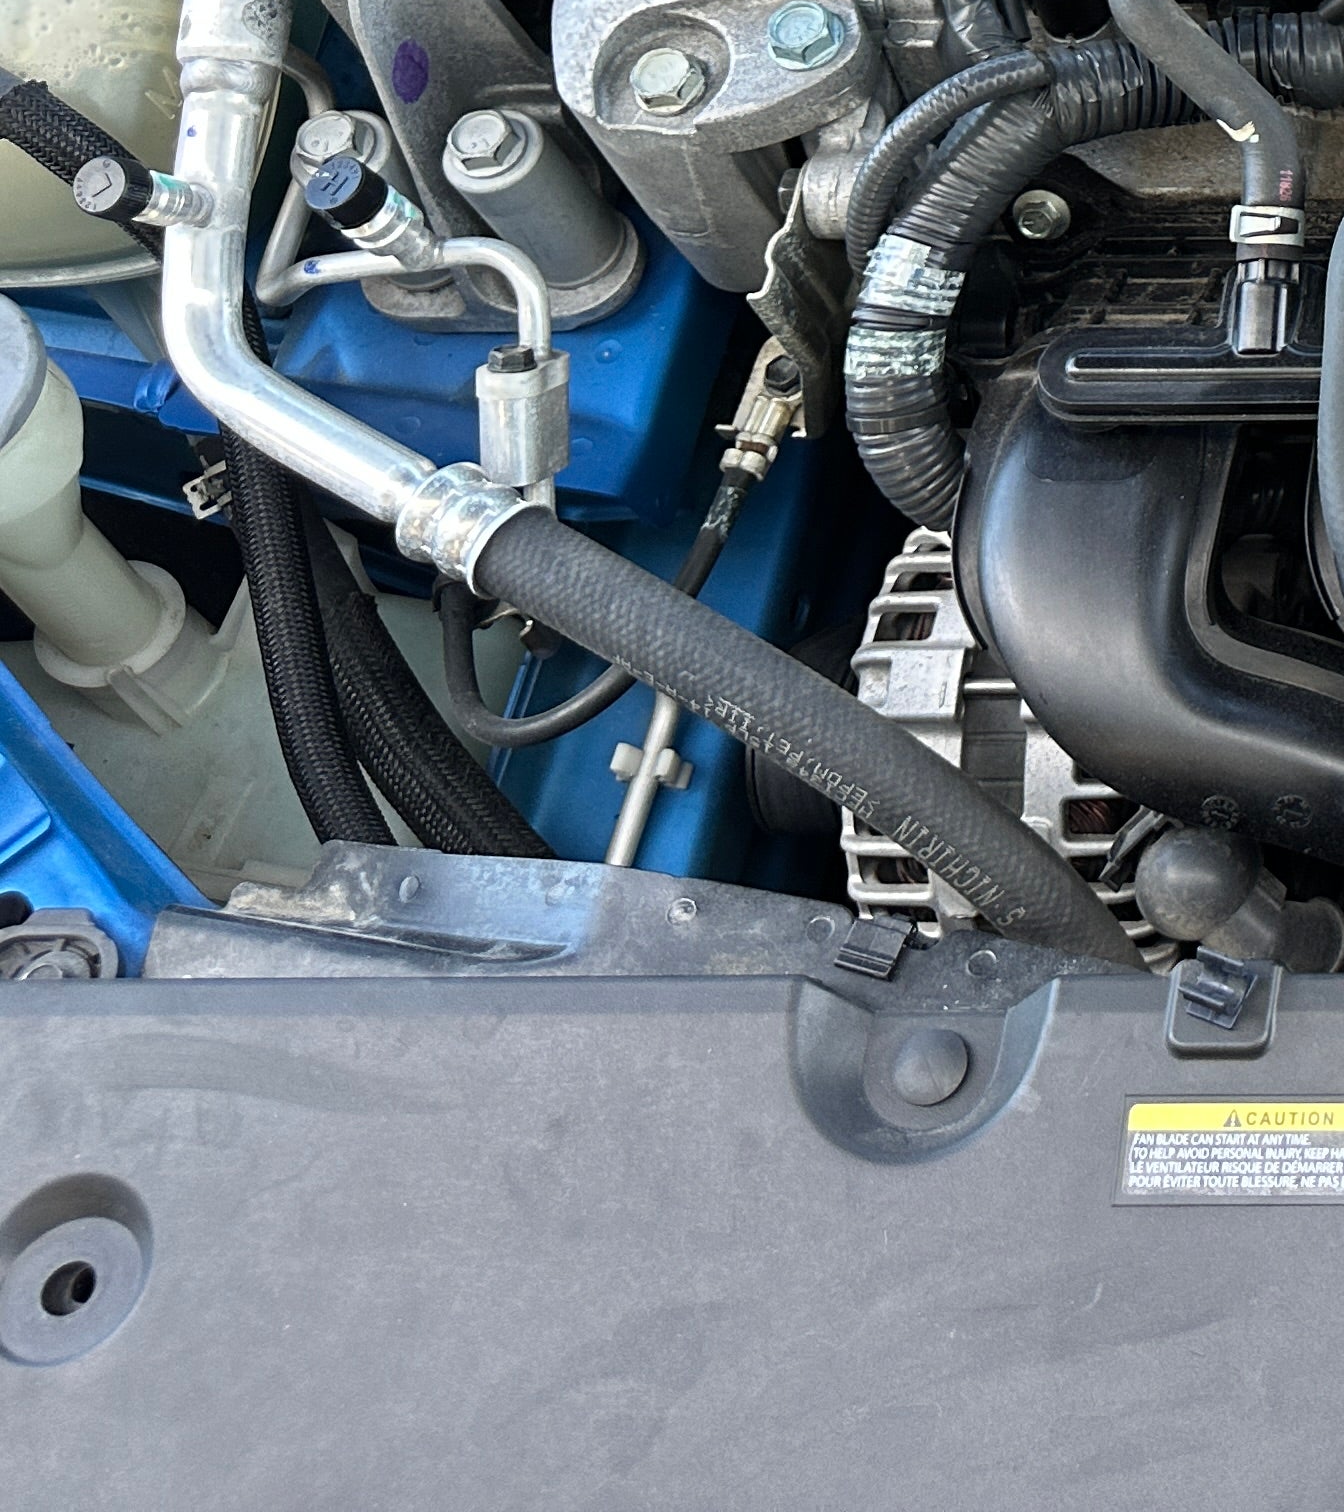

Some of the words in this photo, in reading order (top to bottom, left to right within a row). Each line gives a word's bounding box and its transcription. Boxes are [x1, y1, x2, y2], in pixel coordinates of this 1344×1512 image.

[1246, 1112, 1334, 1126] CAUTION
[1133, 1134, 1154, 1145] FAN
[1156, 1134, 1188, 1145] BLADE
[1191, 1134, 1214, 1145] CAN
[1216, 1134, 1245, 1145] START
[1247, 1134, 1259, 1145] AT
[1262, 1134, 1283, 1145] ANY
[1286, 1134, 1311, 1145] TIME.
[1133, 1147, 1148, 1160] TO
[1149, 1147, 1176, 1160] HELP
[1177, 1147, 1209, 1160] AVOID
[1211, 1147, 1263, 1160] PERSONAL
[1266, 1147, 1302, 1160] INJURY,
[1304, 1147, 1329, 1160] KEEP
[1129, 1161, 1144, 1174] LE
[1146, 1161, 1219, 1174] VENTILATEUR
[1221, 1161, 1262, 1174] RISQUE
[1264, 1161, 1280, 1174] DE
[1282, 1161, 1343, 1174] DÉMARRER
[1128, 1175, 1161, 1188] POUR
[1163, 1175, 1200, 1188] ÉVITER
[1203, 1175, 1238, 1188] TOUTE
[1240, 1175, 1299, 1188] BLESSURE,
[1301, 1175, 1317, 1188] NE
[1318, 1175, 1339, 1188] PAS
